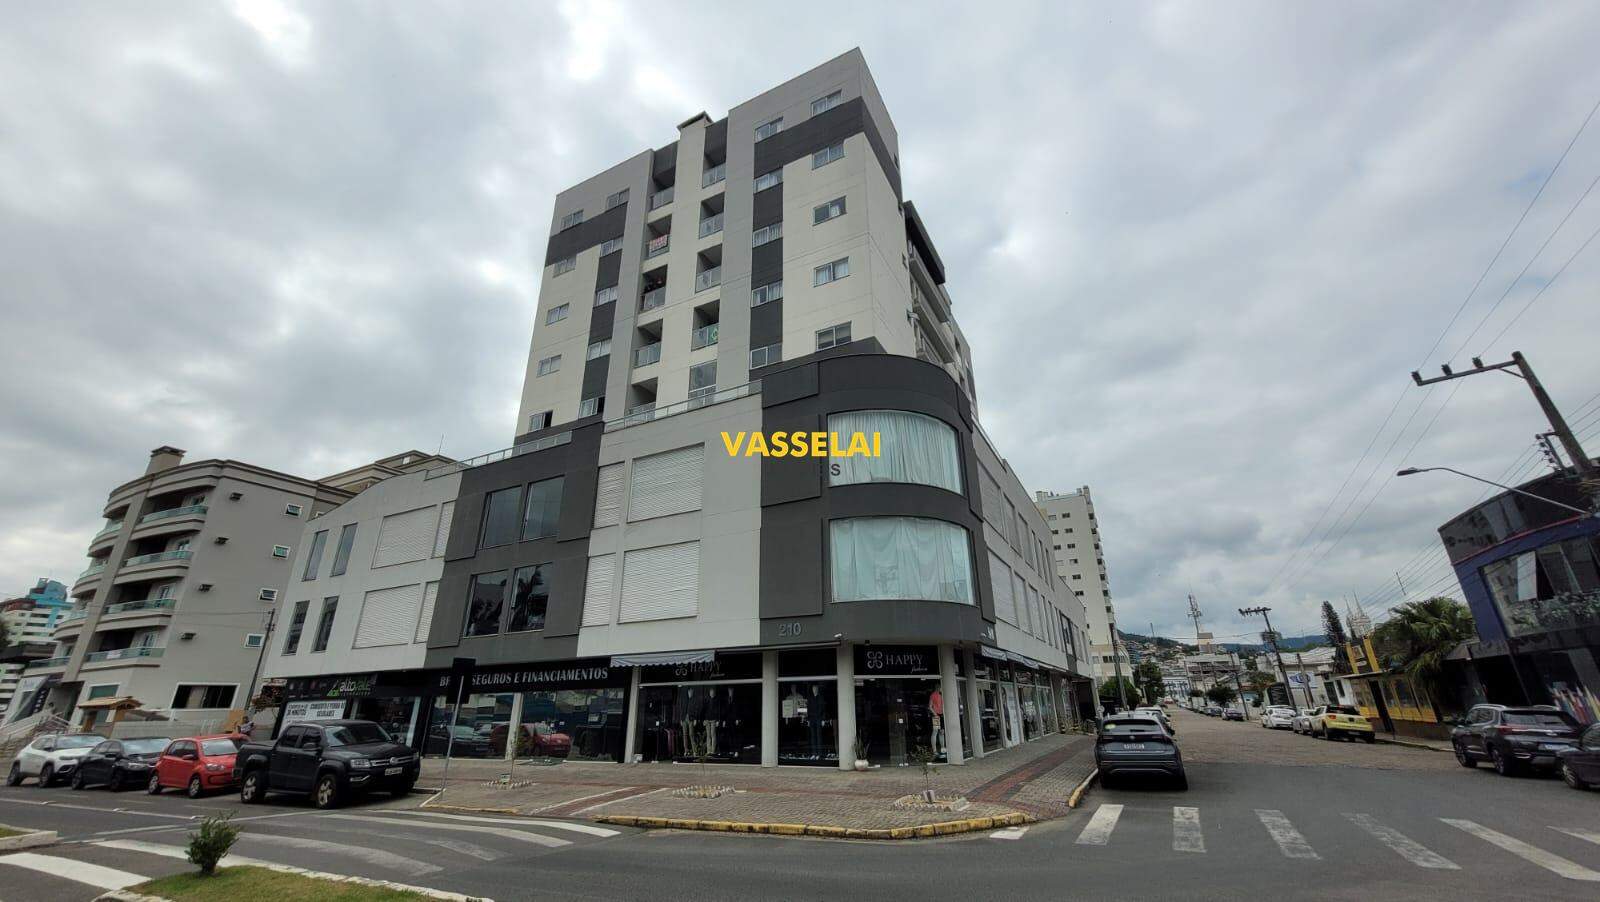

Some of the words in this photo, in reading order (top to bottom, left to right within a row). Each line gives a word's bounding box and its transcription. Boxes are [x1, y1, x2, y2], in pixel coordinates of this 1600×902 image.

[779, 622, 801, 636] 210
[885, 653, 923, 665] HAPPY
[472, 672, 512, 686] SEGUROS
[514, 671, 521, 683] E
[522, 667, 609, 683] FINANCIAMENTOS
